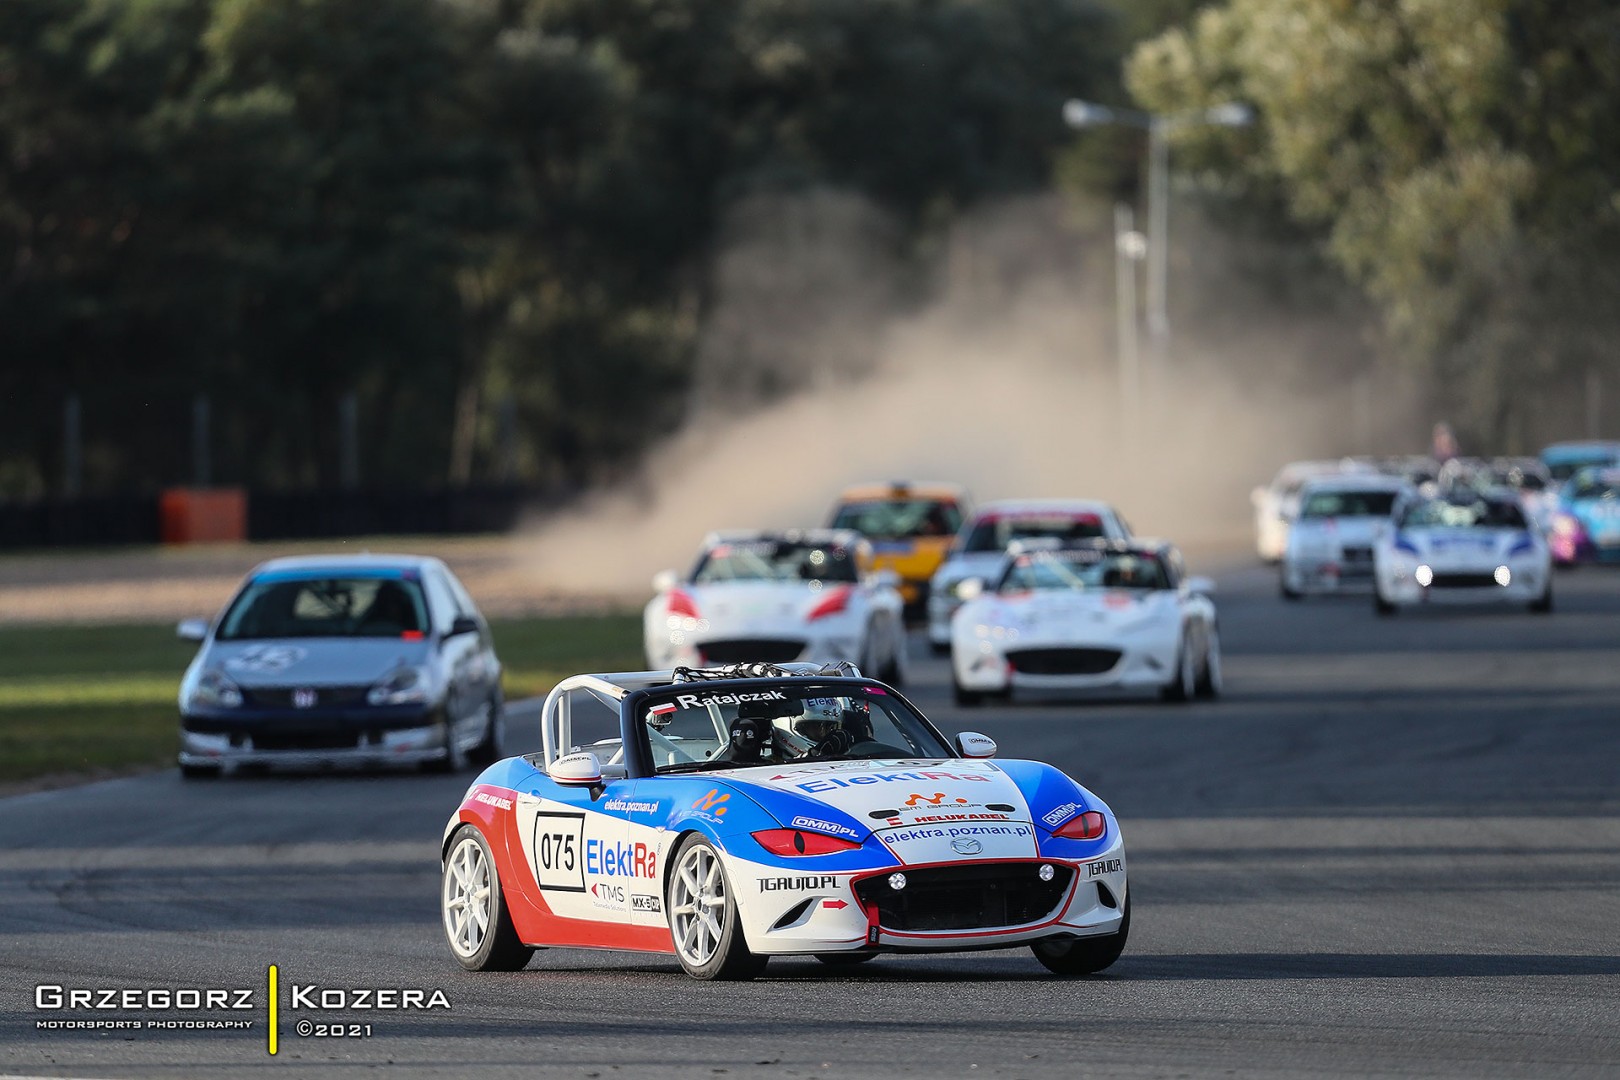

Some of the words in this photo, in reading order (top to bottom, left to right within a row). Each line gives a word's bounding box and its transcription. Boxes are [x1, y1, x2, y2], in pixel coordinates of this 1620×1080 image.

[677, 690, 787, 710] Ratajczak
[795, 770, 992, 794] ElektRa
[604, 798, 660, 815] elektra.poznan.pl
[914, 814, 1010, 823] HELUKABEL
[884, 825, 1032, 844] elektra.poznan.pl
[541, 832, 575, 871] 075
[587, 839, 656, 879] ElektRa
[600, 883, 625, 903] TMS
[756, 876, 842, 894] TGAUTO.PL
